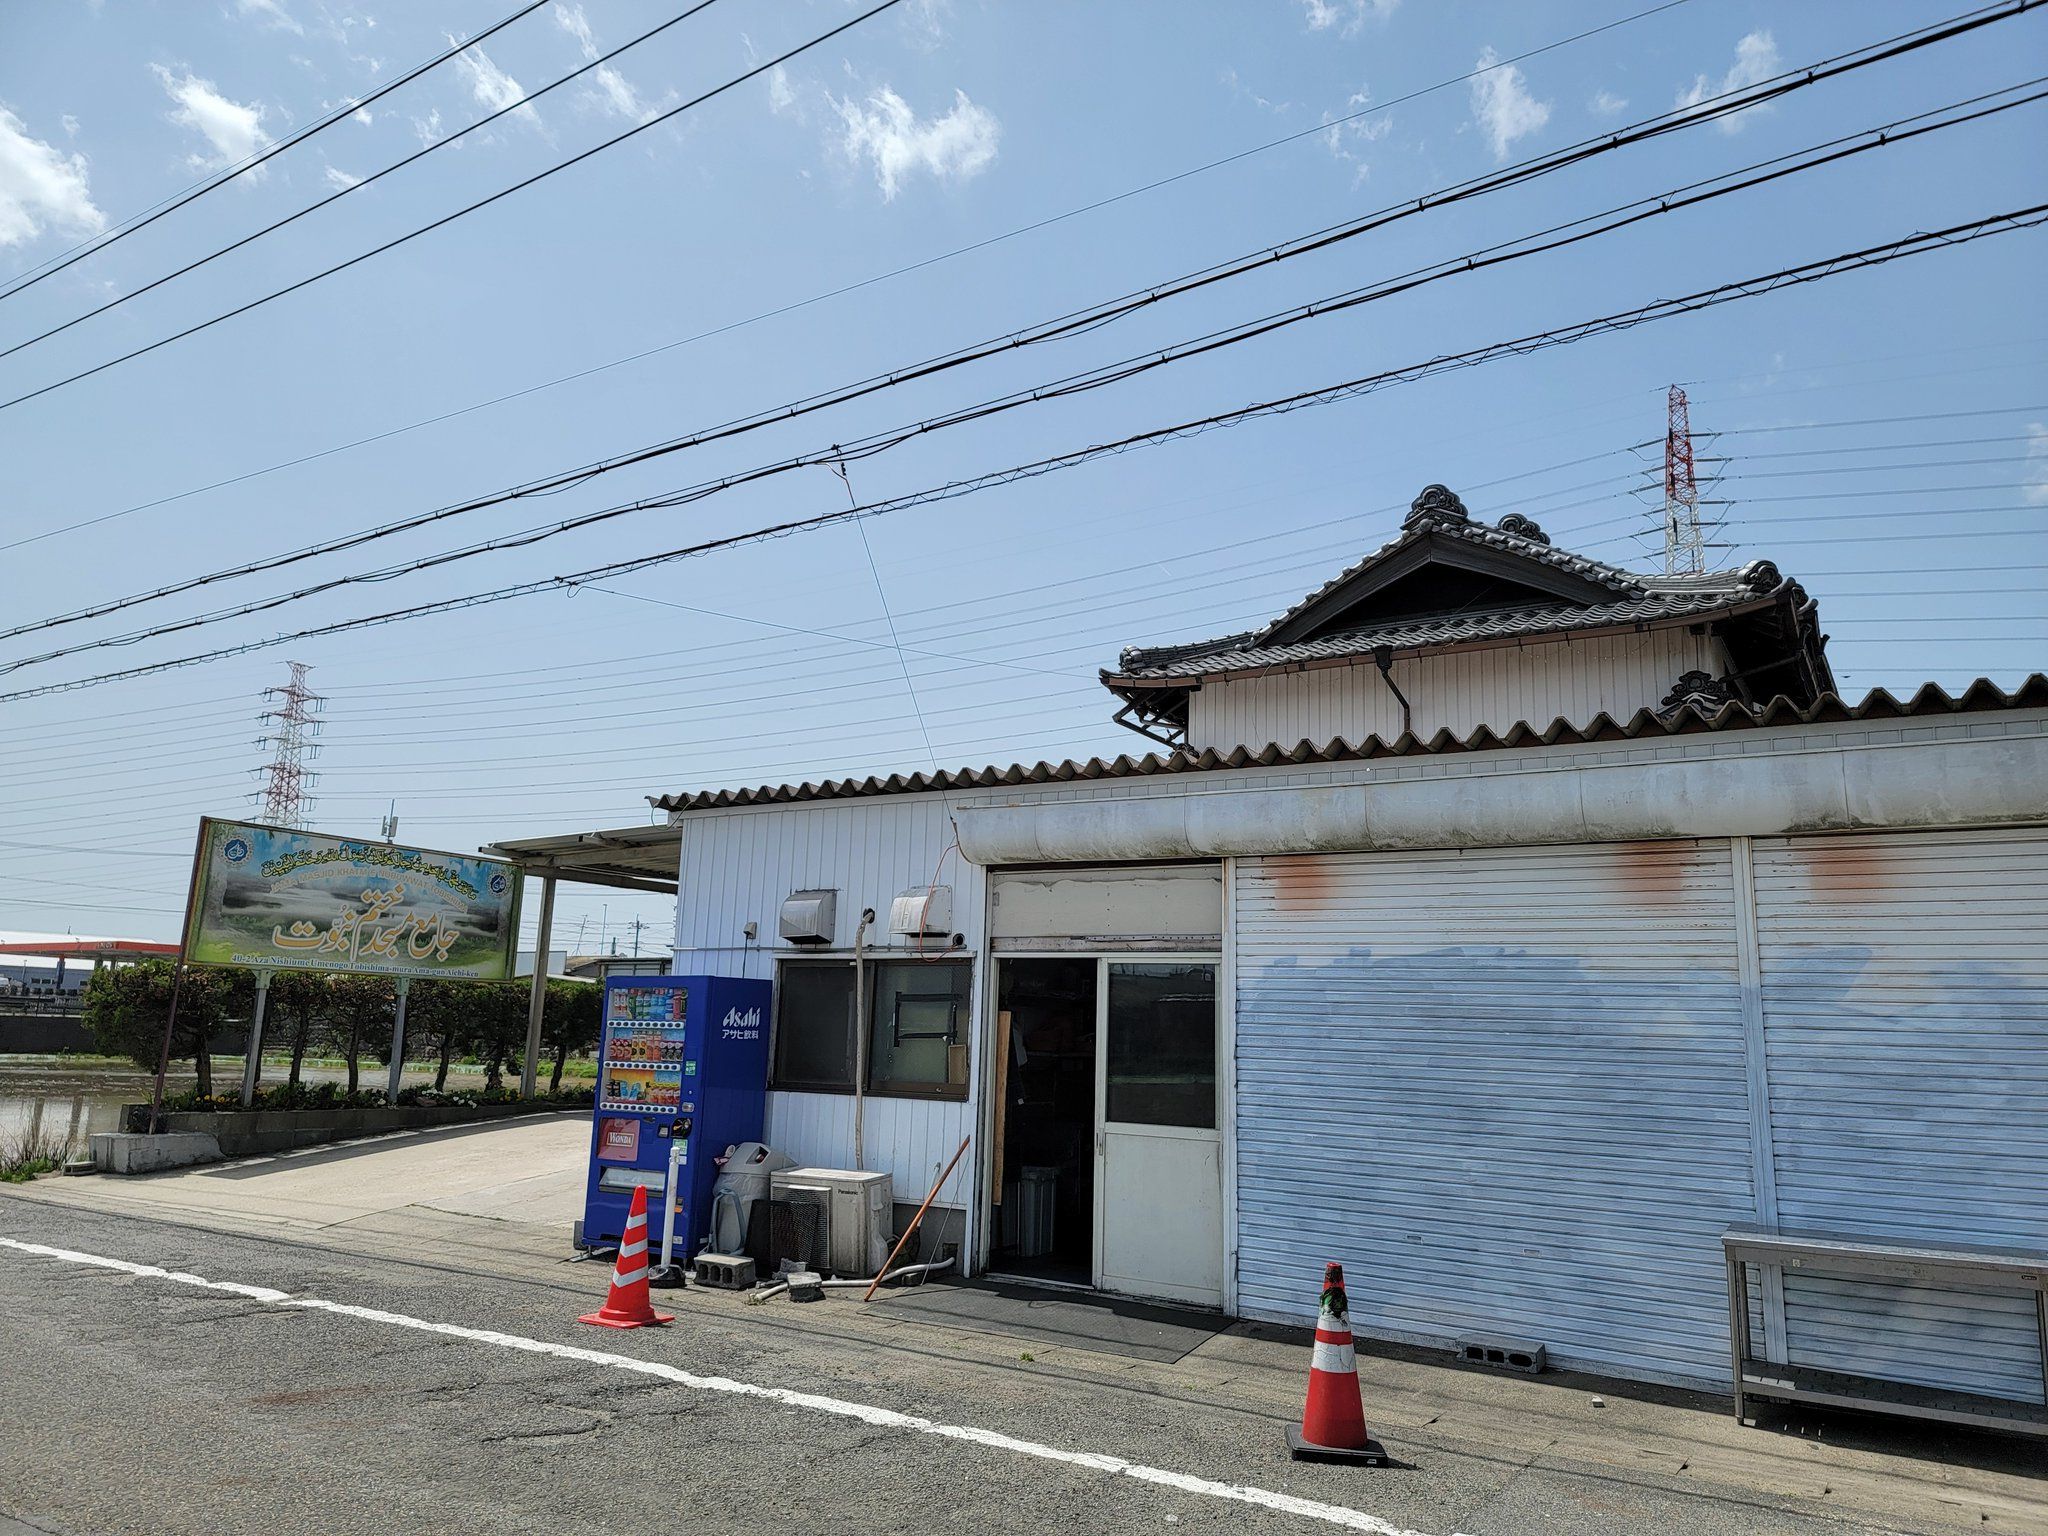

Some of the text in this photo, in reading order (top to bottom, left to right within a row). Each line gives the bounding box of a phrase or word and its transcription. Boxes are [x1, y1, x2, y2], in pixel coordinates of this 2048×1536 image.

[251, 956, 269, 964] Aza
[722, 1006, 760, 1028] Asahi
[722, 1029, 759, 1040] アサヒ飲料
